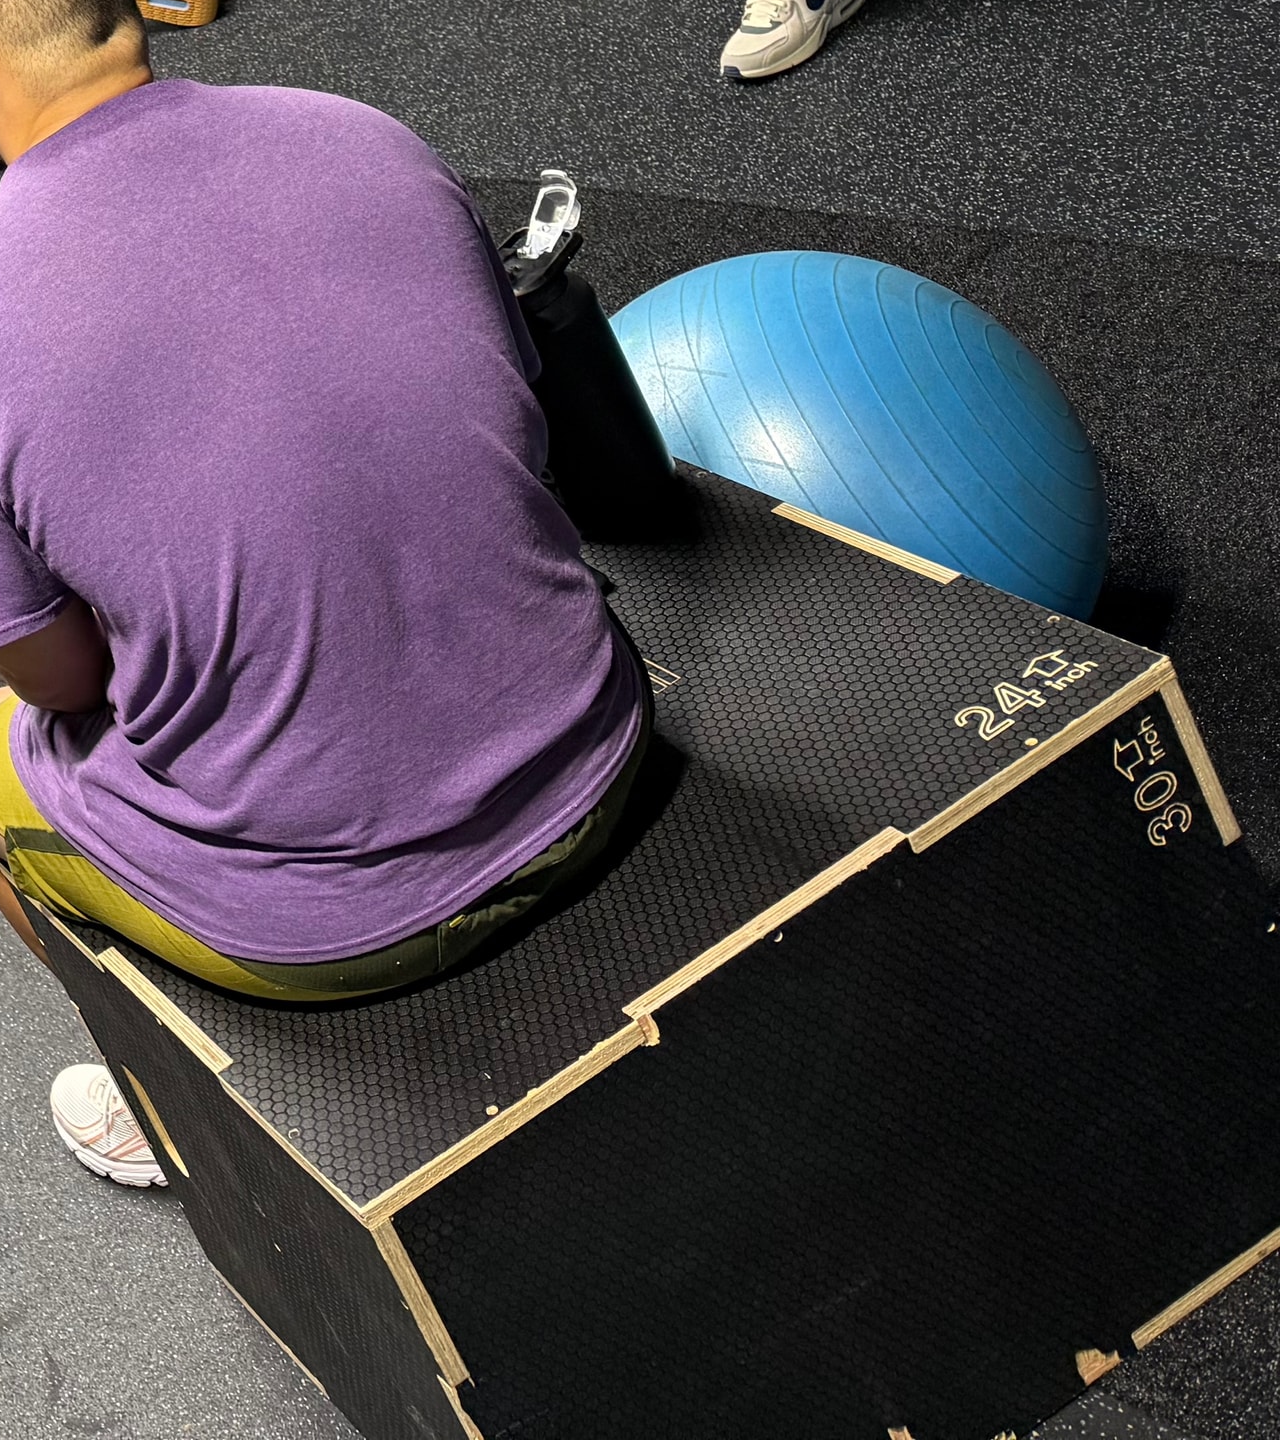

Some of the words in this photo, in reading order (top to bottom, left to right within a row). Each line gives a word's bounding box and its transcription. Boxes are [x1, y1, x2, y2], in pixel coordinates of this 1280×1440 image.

[954, 681, 1046, 741] 24
[1045, 659, 1099, 691] inch
[1138, 714, 1166, 766] inch
[1134, 770, 1192, 846] 30
